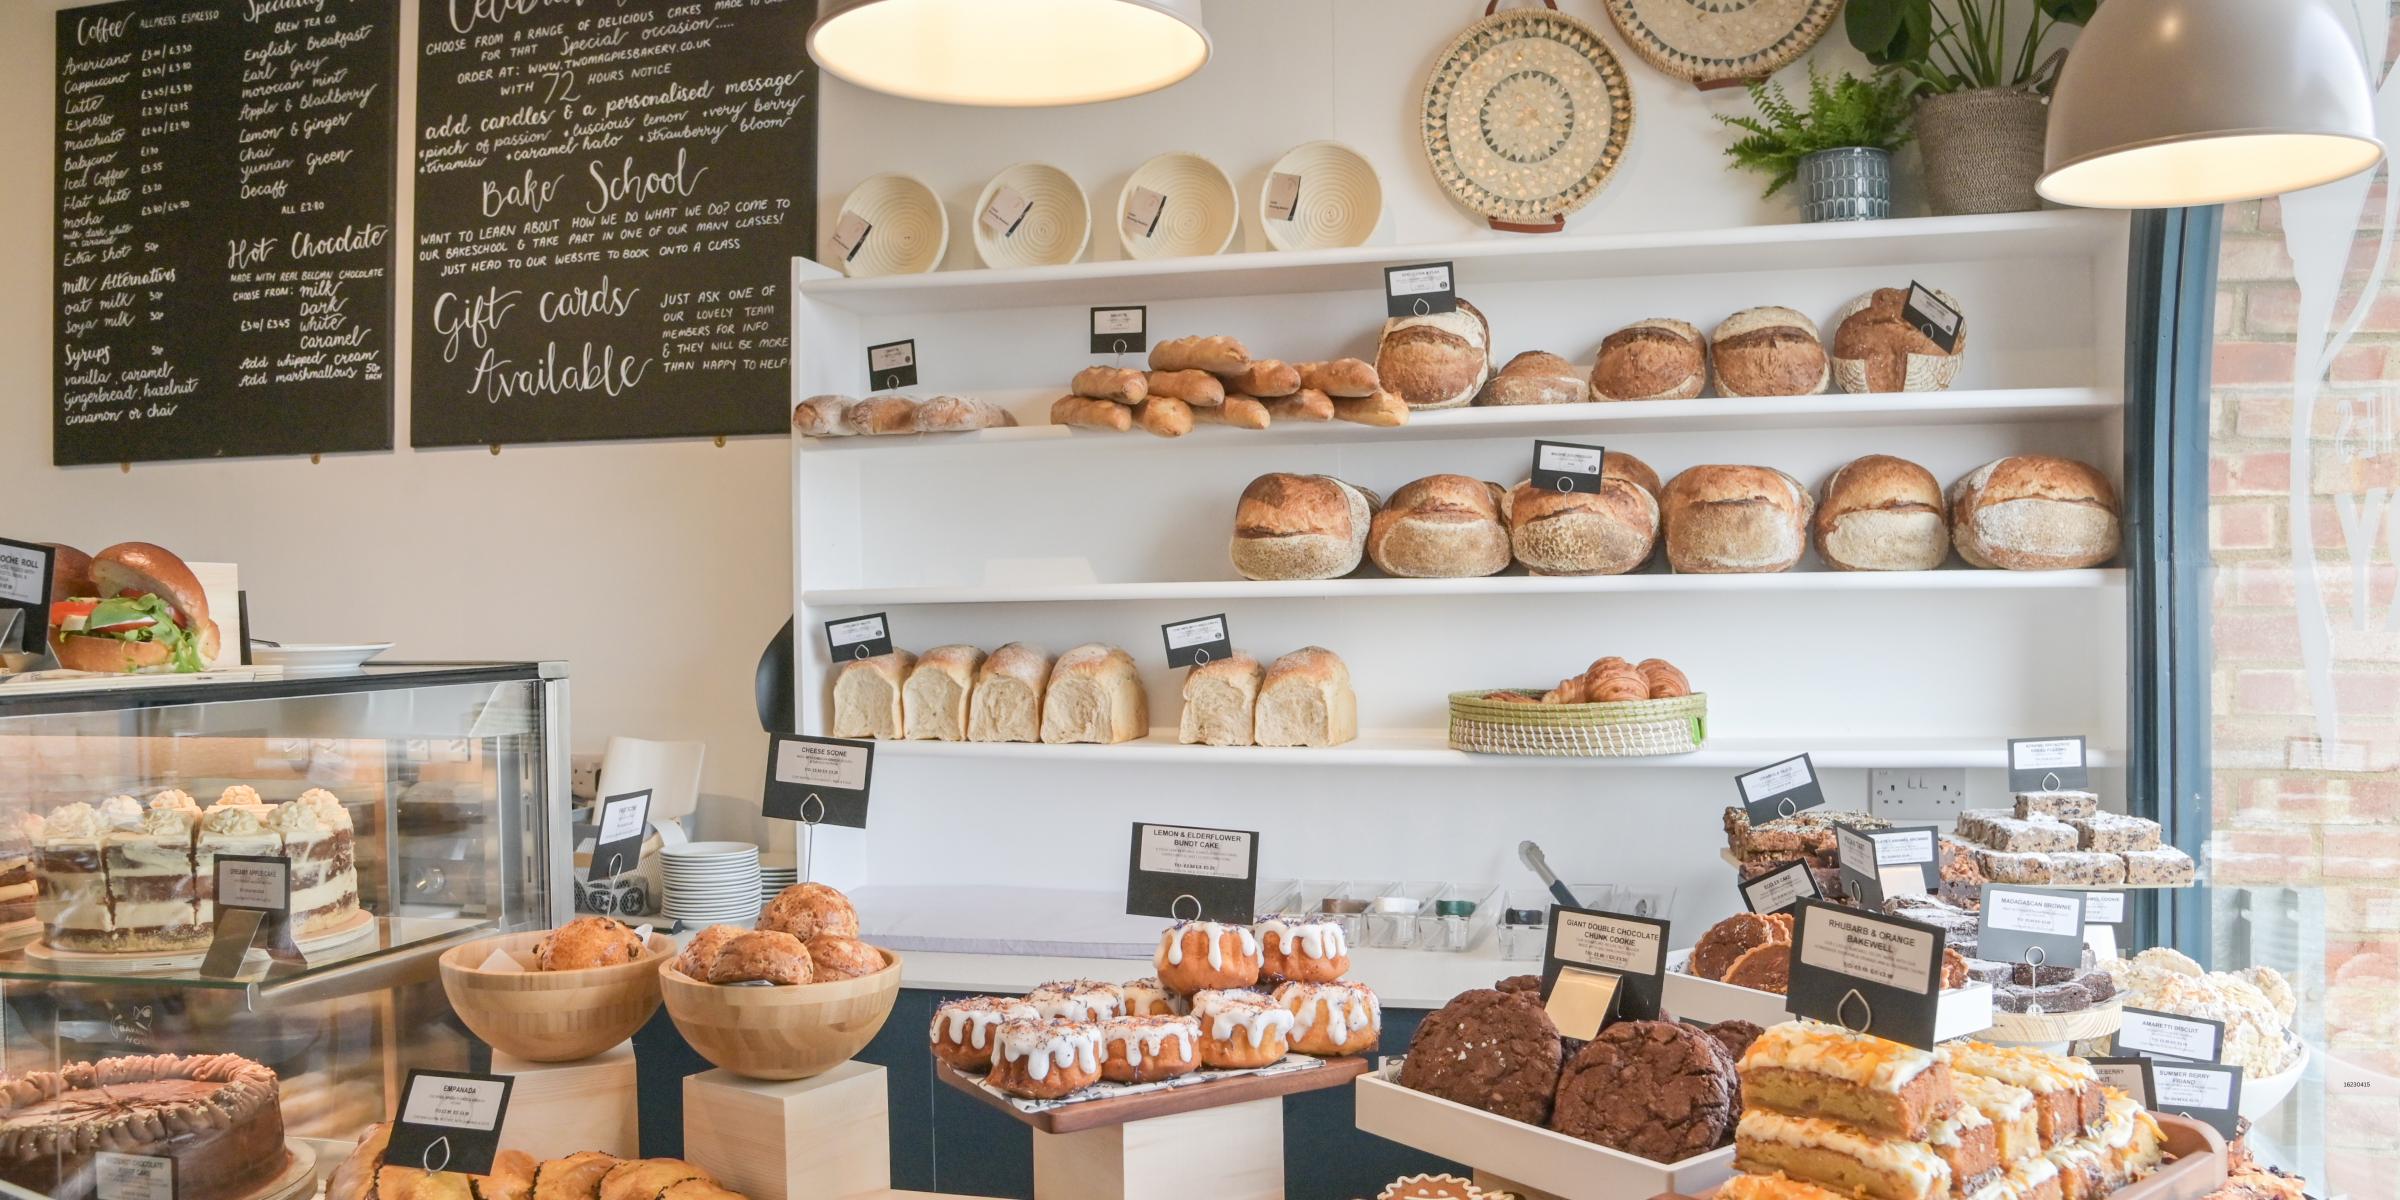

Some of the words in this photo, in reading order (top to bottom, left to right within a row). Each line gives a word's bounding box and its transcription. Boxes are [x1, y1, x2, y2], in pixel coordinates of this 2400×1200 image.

[77, 12, 135, 46] Coffee
[274, 21, 299, 34] BREW
[304, 17, 321, 28] TEA
[324, 14, 337, 24] CO
[244, 40, 298, 66] English
[306, 24, 374, 51] Breakfast
[481, 51, 501, 63] FOR
[510, 44, 539, 58] THAT
[560, 28, 629, 56] Special
[63, 53, 132, 76] Americano
[242, 62, 277, 83] Earl
[289, 56, 329, 80] Grey
[457, 68, 494, 85] ORDER
[498, 66, 521, 79] AT:
[64, 72, 131, 95] Cappuccino
[500, 81, 535, 96] WITH
[542, 70, 582, 105] 72
[587, 69, 625, 85] HOURS
[630, 62, 673, 79] NOTICE
[65, 95, 105, 115] Latte
[238, 99, 279, 121] Apple
[285, 99, 293, 113] &
[300, 83, 378, 110] Blackberry
[425, 113, 472, 140] add
[480, 106, 556, 133] candles
[563, 104, 574, 120] &
[582, 104, 598, 117] a
[604, 79, 716, 119] personalised
[725, 69, 805, 97] message
[66, 114, 115, 134] Espresso
[239, 126, 284, 143] Lemon
[290, 122, 299, 137] &
[303, 112, 353, 140] Ginger
[475, 141, 491, 155] of
[493, 130, 552, 152] passion
[643, 110, 689, 127] lemon
[753, 95, 806, 116] berry
[582, 132, 624, 151] halo
[739, 116, 793, 133] bloom
[305, 149, 354, 176] Green
[64, 176, 88, 190] Iced
[93, 168, 130, 187] Coffee
[240, 179, 289, 200] Decaff
[482, 168, 566, 218] Bake
[586, 147, 710, 215] School
[63, 194, 94, 212] Flat
[281, 205, 297, 215] ALL
[420, 231, 452, 246] WANT
[458, 230, 474, 243] TO
[479, 224, 518, 240] LEARN
[523, 218, 561, 235] ABOUT
[571, 215, 596, 229] HOW
[600, 213, 618, 226] WE
[624, 211, 639, 224] DO
[645, 207, 678, 221] WHAT
[684, 204, 702, 217] WE
[707, 201, 731, 216] DO?
[735, 199, 768, 213] COME
[775, 198, 791, 210] TO
[228, 237, 279, 270] Hot
[291, 223, 389, 260] Chocolate
[63, 250, 97, 267] Extra
[100, 267, 176, 292] Alternatives
[100, 292, 136, 310] milk
[232, 289, 261, 302] CHOOSE
[300, 295, 349, 317] Dark
[660, 292, 692, 309] JUST
[697, 290, 721, 304] ASK
[728, 287, 754, 300] ONE
[761, 285, 777, 297] OF
[104, 311, 136, 327] milk
[433, 286, 523, 363] Gift
[663, 311, 685, 322] OUR
[696, 307, 734, 321] LOVELY
[744, 305, 775, 317] TEAM
[662, 325, 711, 339] MEMBERS
[716, 323, 736, 335] FOR
[742, 321, 769, 333] INFO
[64, 344, 111, 371] Syrups
[662, 343, 671, 359] &
[677, 342, 704, 355] THEY
[711, 341, 734, 351] WILL
[738, 339, 753, 350] BE
[758, 337, 790, 349] MORE
[121, 360, 175, 381] caramel
[239, 356, 269, 371] Add
[277, 350, 328, 368] whipped
[334, 350, 380, 365] cream
[663, 361, 695, 373] THAN
[702, 359, 737, 372] HAPPY
[743, 359, 757, 370] TO
[238, 372, 268, 388] Add
[275, 364, 358, 383] marshmallows
[467, 341, 654, 404] Available
[143, 378, 200, 397] hazelnut
[65, 410, 124, 427] cinnamon
[128, 408, 143, 421] or
[147, 403, 179, 418] chai
[21, 558, 40, 569] ROLL
[801, 746, 826, 756] CHEESE
[826, 749, 848, 758] SCONE
[1153, 828, 1180, 838] LEMON
[1187, 831, 1242, 842] ELDERFLOWER
[1174, 839, 1198, 848] BUNDT
[1199, 841, 1220, 850] CAKE
[2001, 897, 2043, 908] MADAGASCAN
[2043, 902, 2072, 911] BROWNIE
[1566, 919, 1587, 929] GIANT
[1587, 922, 1616, 934] DOUBLE
[1617, 928, 1660, 942] CHOCOLATE
[1584, 931, 1609, 942] CHUNK
[1609, 935, 1636, 947] COOKIE
[1828, 919, 1870, 936] RHUBARB
[1871, 929, 1878, 938] &
[1878, 931, 1917, 948] ORANGE
[1846, 934, 1894, 954] BAKEWELL
[2142, 1020, 2173, 1031] AMARETTI
[2173, 1025, 2200, 1034] BISCUIT
[2159, 1070, 2188, 1078] SUMMER
[2188, 1072, 2211, 1080] BERRY
[443, 1084, 477, 1095] EMPANADA
